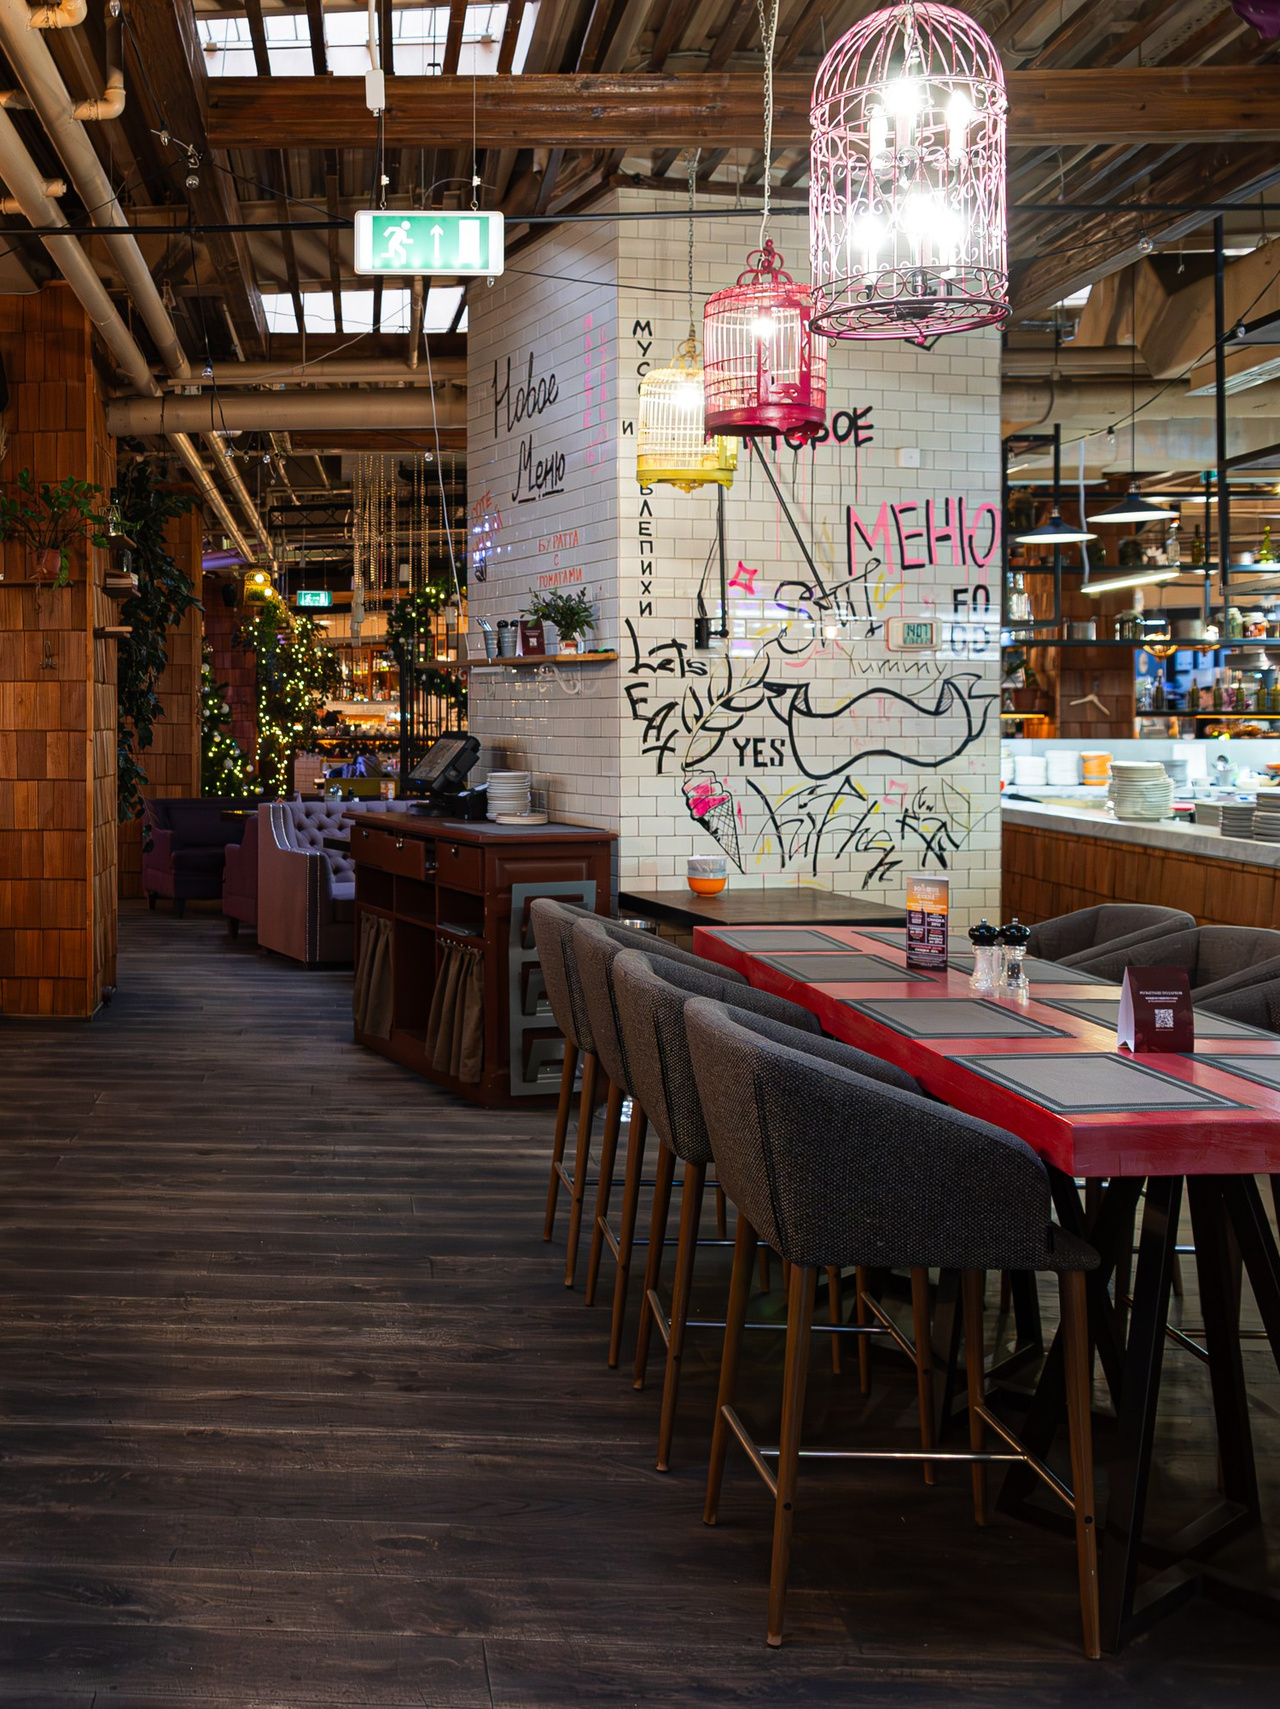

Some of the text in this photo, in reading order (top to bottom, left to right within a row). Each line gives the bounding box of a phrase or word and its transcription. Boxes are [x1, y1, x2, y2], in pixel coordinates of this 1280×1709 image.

[633, 319, 653, 395] МУС
[491, 351, 560, 440] Новое
[511, 434, 566, 503] Меню
[846, 496, 1002, 577] МЕНЮ
[732, 737, 786, 768] YES
